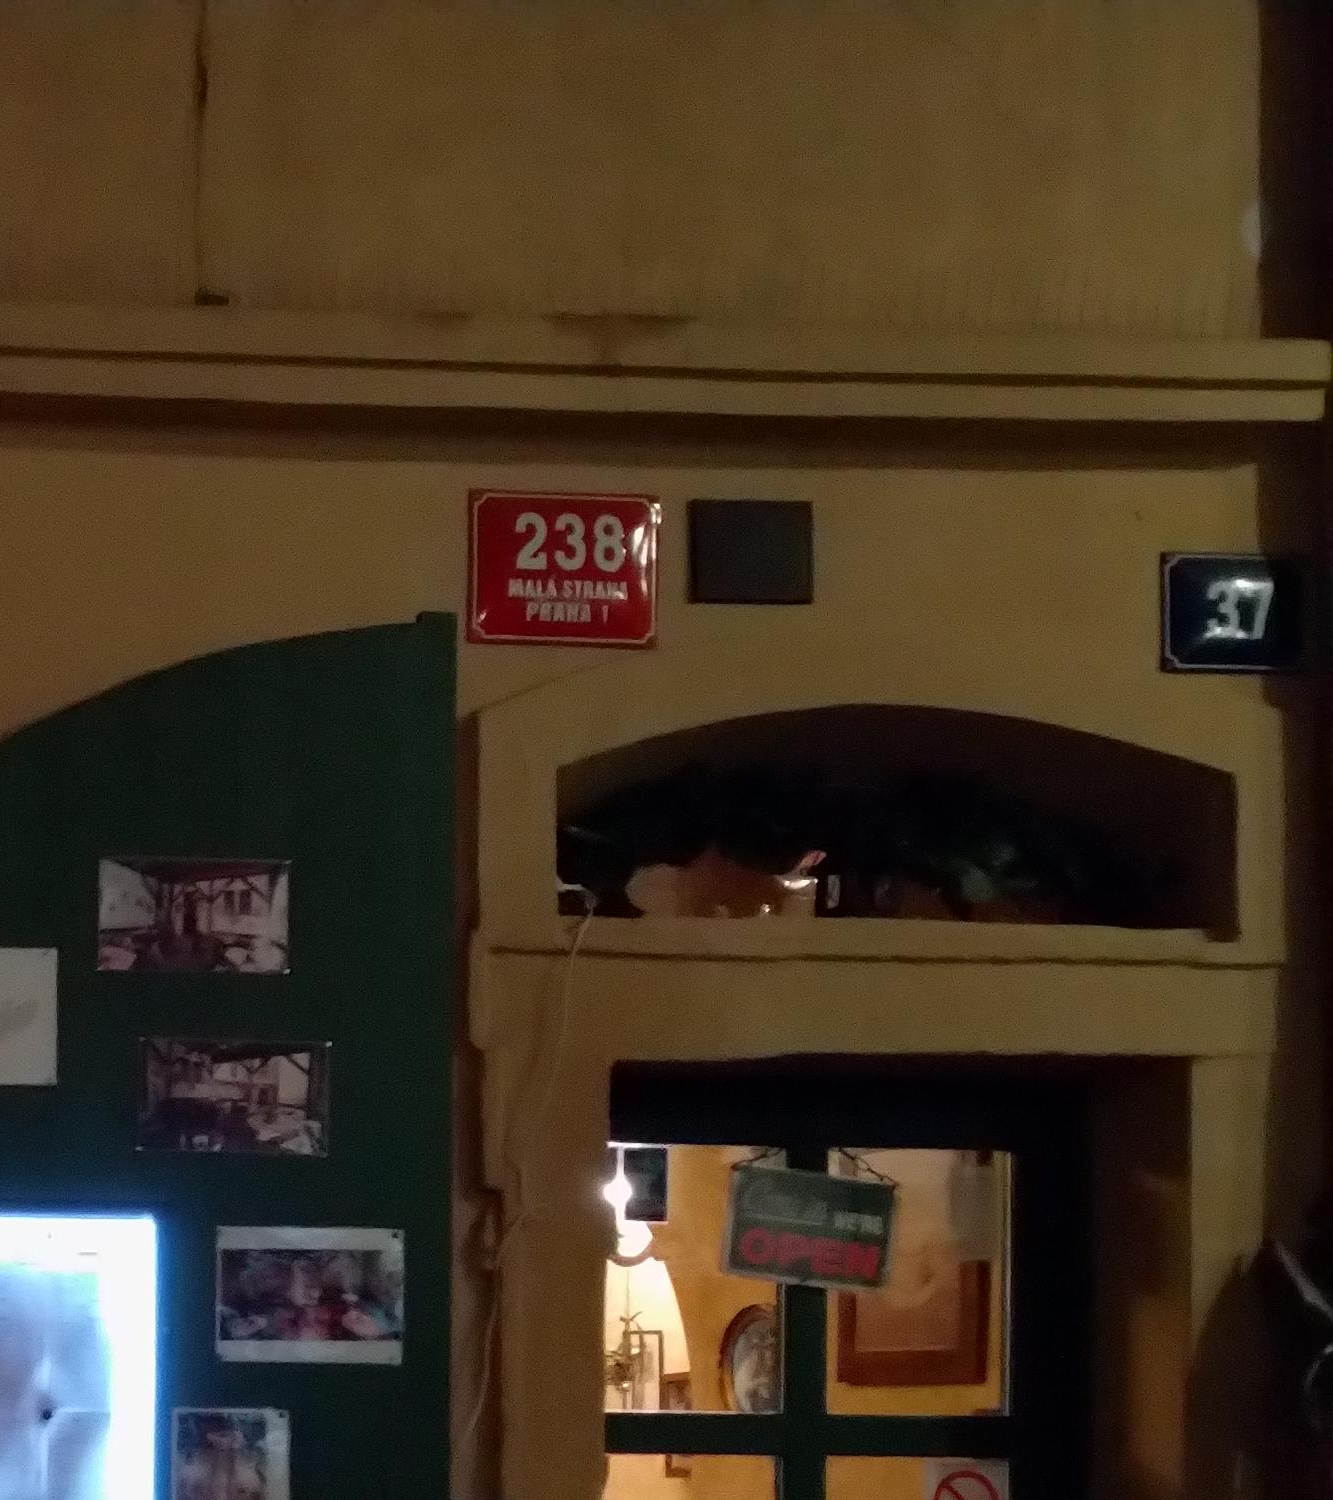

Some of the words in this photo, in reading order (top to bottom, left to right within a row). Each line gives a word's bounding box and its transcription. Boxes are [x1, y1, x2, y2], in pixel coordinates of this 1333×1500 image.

[514, 511, 627, 573] 238
[525, 601, 592, 624] PRAHA
[601, 604, 610, 625] 1
[1205, 577, 1275, 640] 37
[740, 1225, 881, 1280] OPEN
